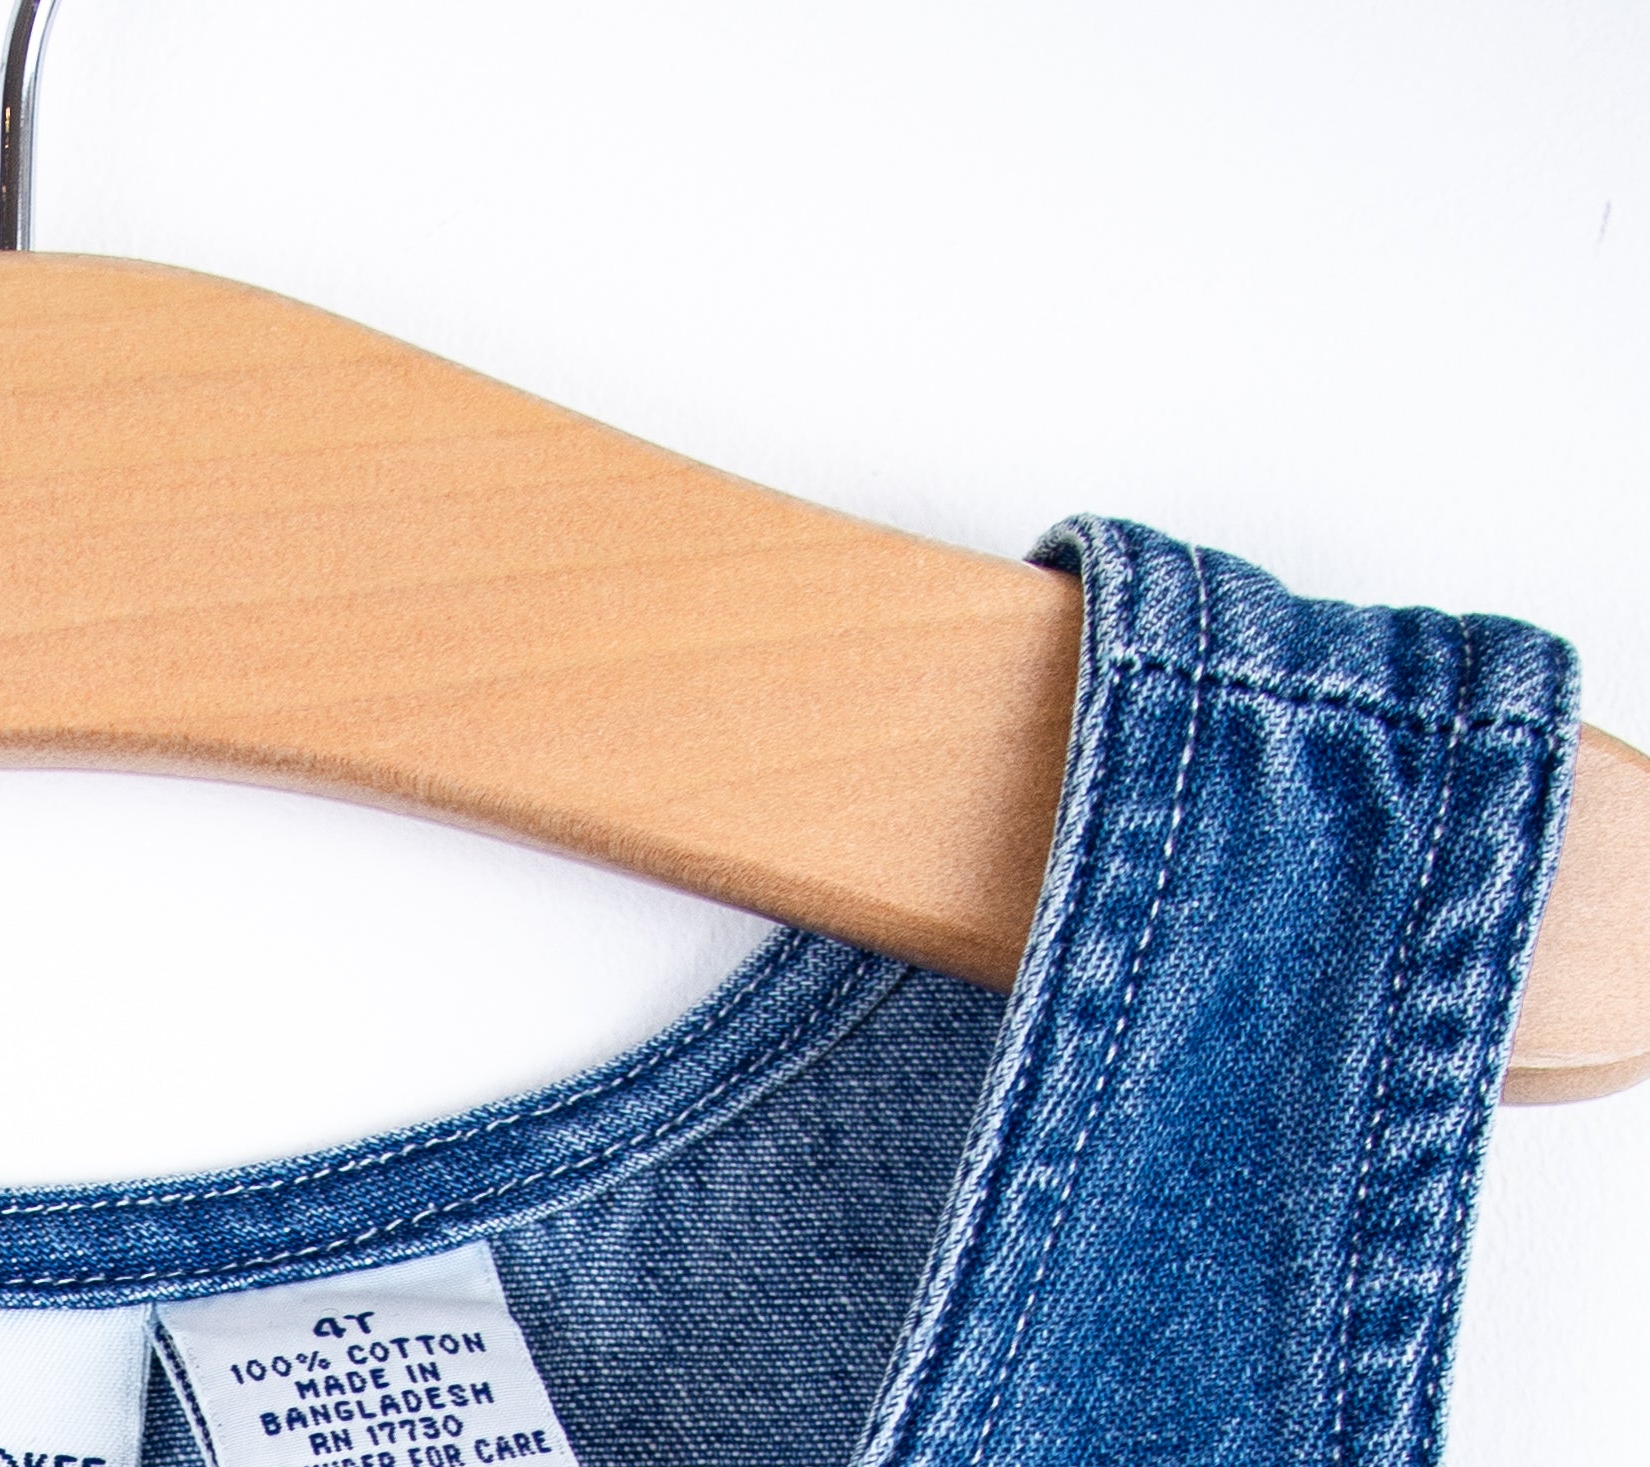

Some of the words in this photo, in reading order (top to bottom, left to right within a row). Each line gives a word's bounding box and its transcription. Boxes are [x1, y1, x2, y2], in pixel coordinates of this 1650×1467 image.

[313, 1311, 375, 1338] 4T
[230, 1350, 331, 1384] 100%
[347, 1332, 487, 1365] COTTON
[294, 1368, 390, 1399] MADE
[406, 1361, 441, 1383] IN
[259, 1381, 495, 1436] BANGLADESH
[308, 1428, 353, 1455] RN
[367, 1414, 464, 1445] 17730
[474, 1430, 552, 1463] CARE
